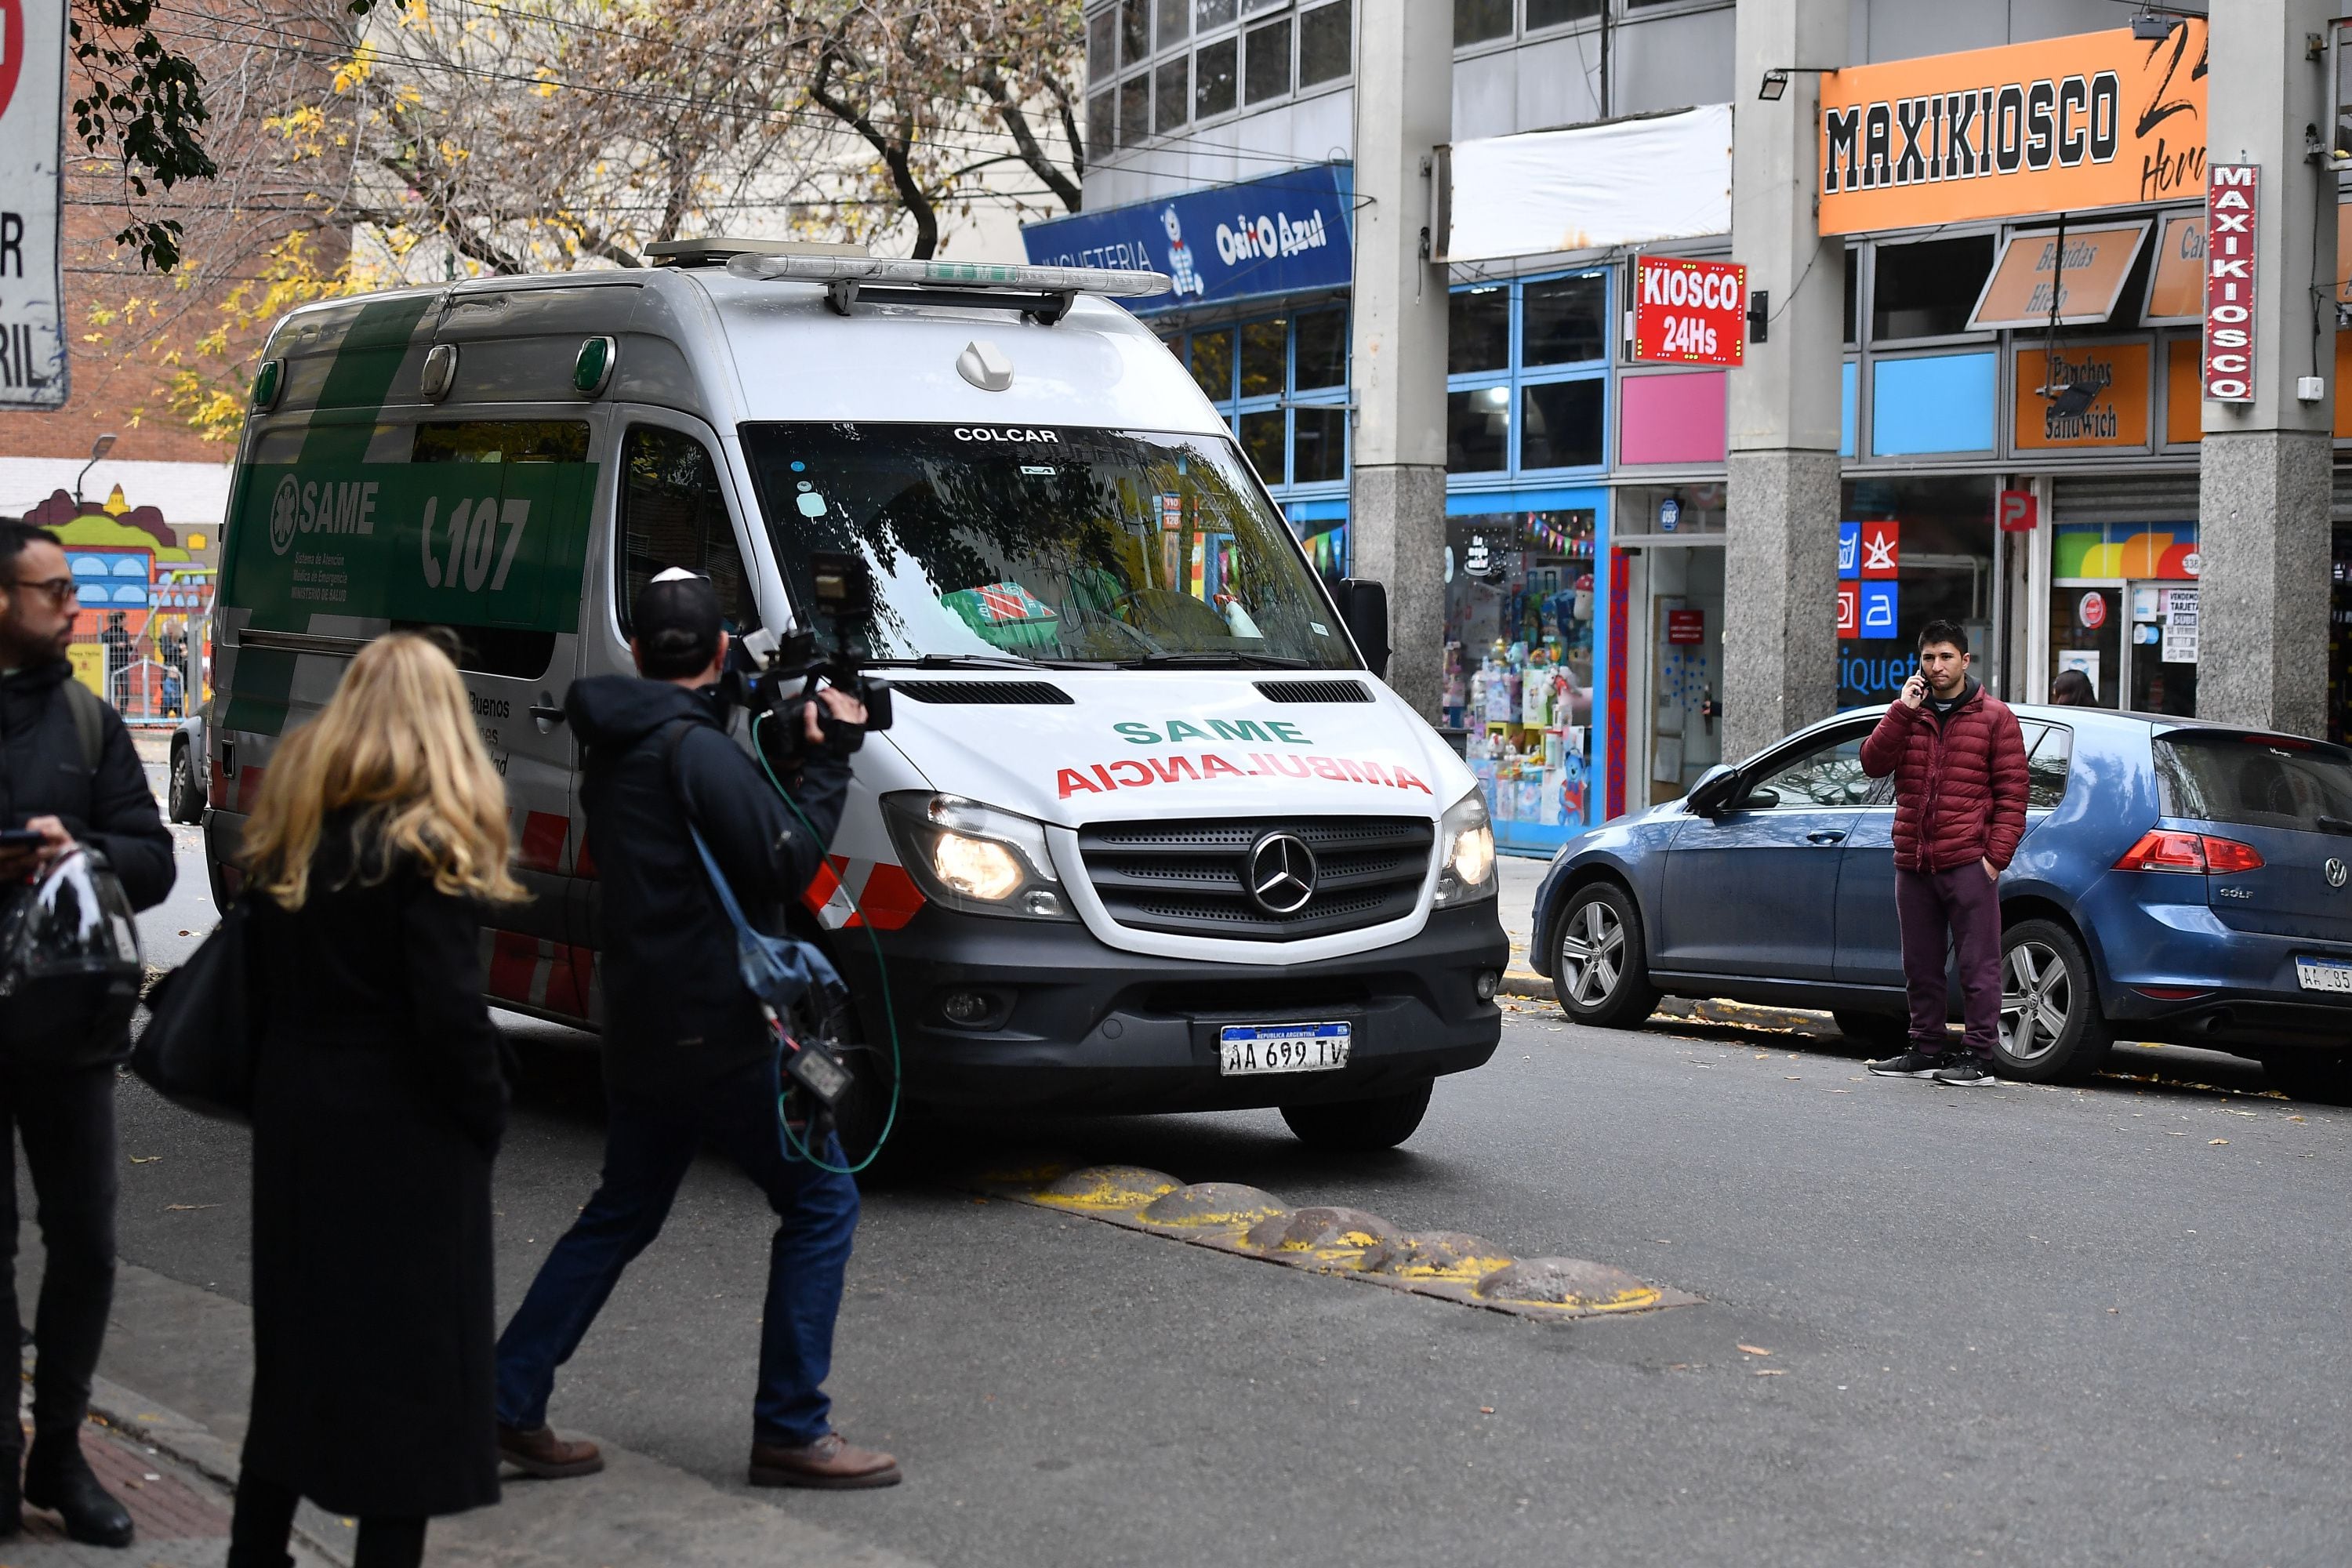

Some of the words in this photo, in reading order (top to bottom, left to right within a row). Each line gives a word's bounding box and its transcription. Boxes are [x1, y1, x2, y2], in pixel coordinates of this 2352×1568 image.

[1824, 70, 2121, 194] MAXIKIOSCO
[1278, 209, 1327, 257] Azul
[2182, 226, 2206, 259] Car
[1644, 267, 1738, 311] KIOSCO
[2210, 167, 2252, 397] MAXIKIOSCO
[1663, 315, 1717, 354] 24Hs
[954, 427, 1058, 443] COLCAR
[299, 481, 379, 534] SAME
[445, 497, 532, 592] 107
[470, 691, 510, 719] Buenos
[1112, 719, 1314, 745] SAME
[2220, 887, 2254, 899] GOLF
[1266, 1041, 1306, 1069] 699
